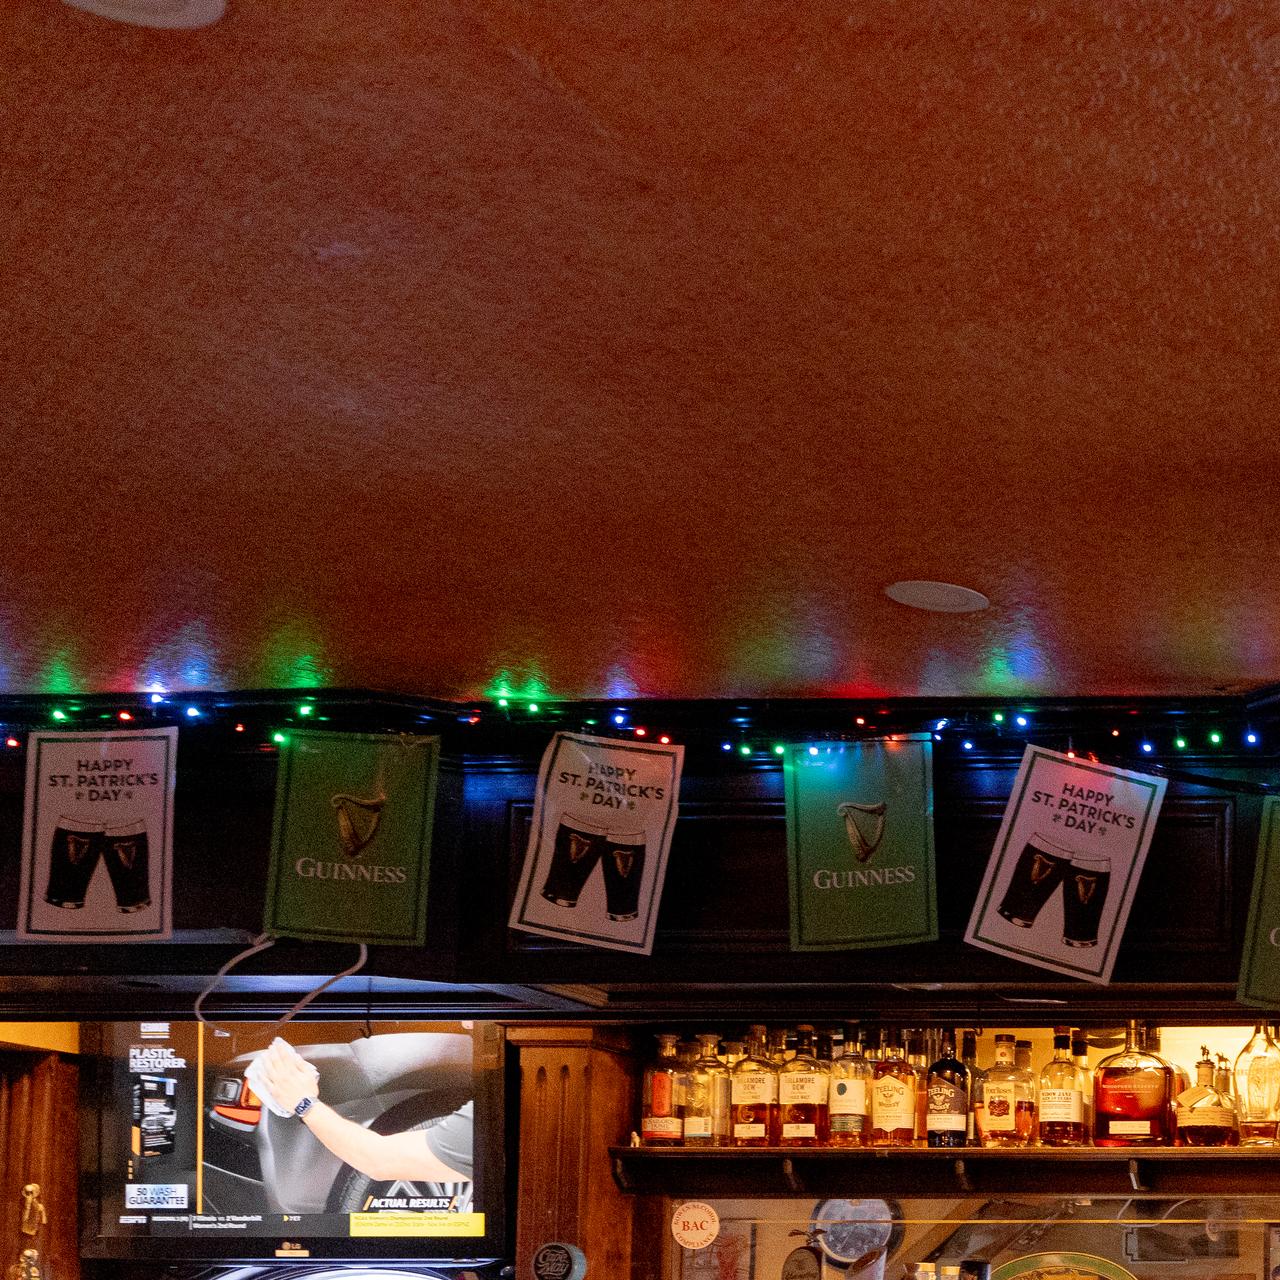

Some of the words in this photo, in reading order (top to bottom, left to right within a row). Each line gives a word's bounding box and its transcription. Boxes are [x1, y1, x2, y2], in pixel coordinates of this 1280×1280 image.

[77, 759, 134, 771] HAPPY
[588, 763, 636, 781] HAPPY
[50, 775, 73, 787] ST.
[78, 773, 158, 787] PATRICK'S
[558, 770, 581, 787] ST.
[586, 776, 665, 800] PATRICK'S
[89, 789, 124, 802] DAY
[592, 792, 624, 809] DAY
[1063, 783, 1114, 806] HAPPY
[1032, 790, 1056, 808] ST.
[1059, 799, 1135, 829] PATRICK'S
[1065, 815, 1096, 834] DAY
[295, 857, 406, 884] GUINNESS
[814, 865, 916, 890] GUINNESS
[129, 1049, 176, 1059] PLASTIC
[129, 1058, 187, 1068] RESTORER
[876, 1086, 904, 1097] TEELING
[928, 1087, 955, 1097] TEELING
[137, 1187, 148, 1196] 50
[149, 1187, 177, 1196] WASH
[128, 1196, 186, 1206] GUARANTEE
[371, 1199, 408, 1209] ACTUAL
[410, 1199, 451, 1209] RESULTS
[683, 1220, 709, 1231] BAC
